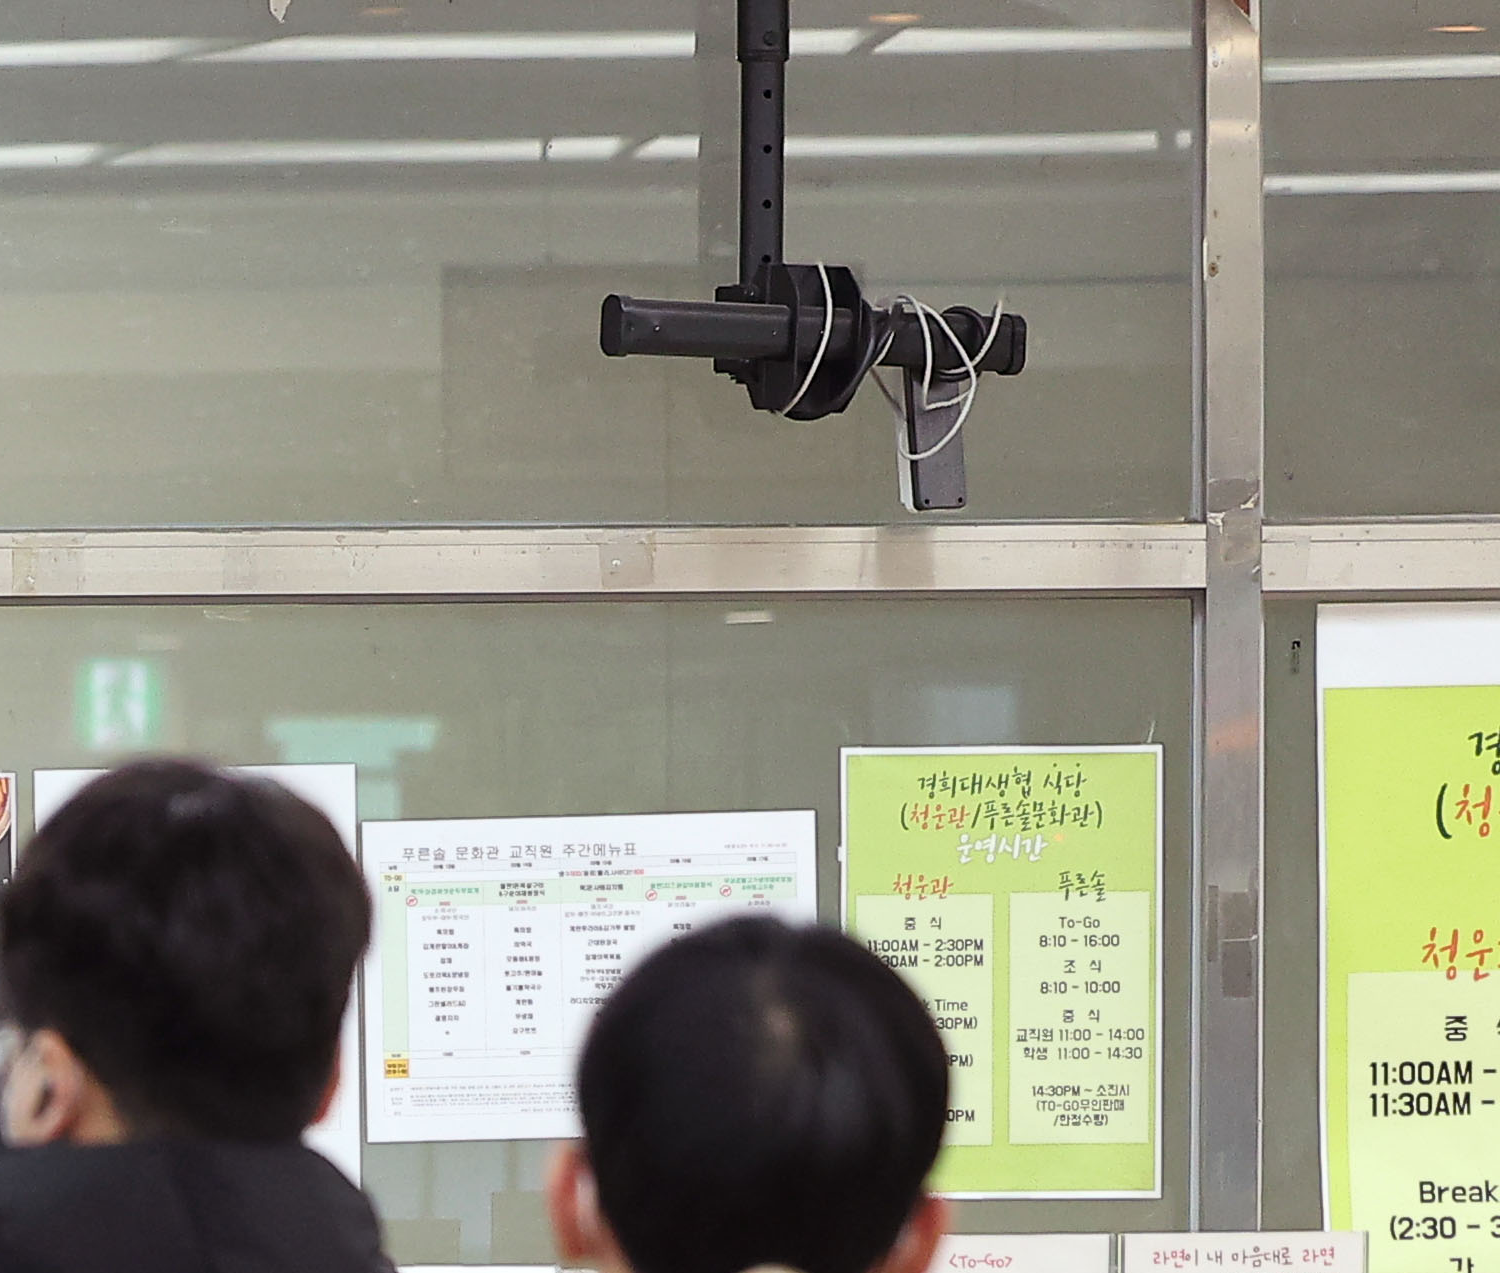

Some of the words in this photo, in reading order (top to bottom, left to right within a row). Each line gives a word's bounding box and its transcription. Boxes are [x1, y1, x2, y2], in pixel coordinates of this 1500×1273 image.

[918, 766, 1031, 799] 경희대생협
[1043, 763, 1087, 797] 식당
[901, 800, 1102, 831] (청운관/푸른솔문화관)
[403, 848, 445, 861] 푸른솔
[456, 846, 499, 860] 문화관
[510, 845, 552, 859] 교직원
[563, 843, 636, 857] 주간메뉴표
[956, 834, 1049, 864] 운영시간
[893, 873, 953, 900] 청운관
[1058, 870, 1107, 902] 푸른솔
[1059, 916, 1100, 928] To-Go
[935, 939, 983, 951] 2:30PM
[1039, 935, 1066, 947] 8:10
[1084, 934, 1119, 947] 16:00
[935, 954, 983, 967] 2:00PM
[1040, 981, 1067, 994] 8:10
[1085, 981, 1120, 993] 10:00
[934, 999, 968, 1011] Time
[1016, 1029, 1053, 1042] 교직원
[1059, 1029, 1091, 1041] 11:00
[1109, 1028, 1144, 1040] 14:00
[1024, 1047, 1047, 1060] 학생
[1058, 1047, 1090, 1060] 11:00
[1108, 1047, 1142, 1059] 14:30
[1370, 1061, 1472, 1086] 11:00AM
[1032, 1085, 1080, 1096] 14:30PM
[1096, 1084, 1129, 1096] 소진시
[1370, 1092, 1470, 1117] 11:30AM
[1419, 1180, 1498, 1203] Break
[1390, 1216, 1456, 1240] (2:30
[949, 1253, 1012, 1268] <To-Go>
[1153, 1249, 1198, 1268] 라면이
[1207, 1251, 1222, 1265] 내
[1231, 1246, 1291, 1267] 마음대로
[1303, 1247, 1334, 1266] 라면
